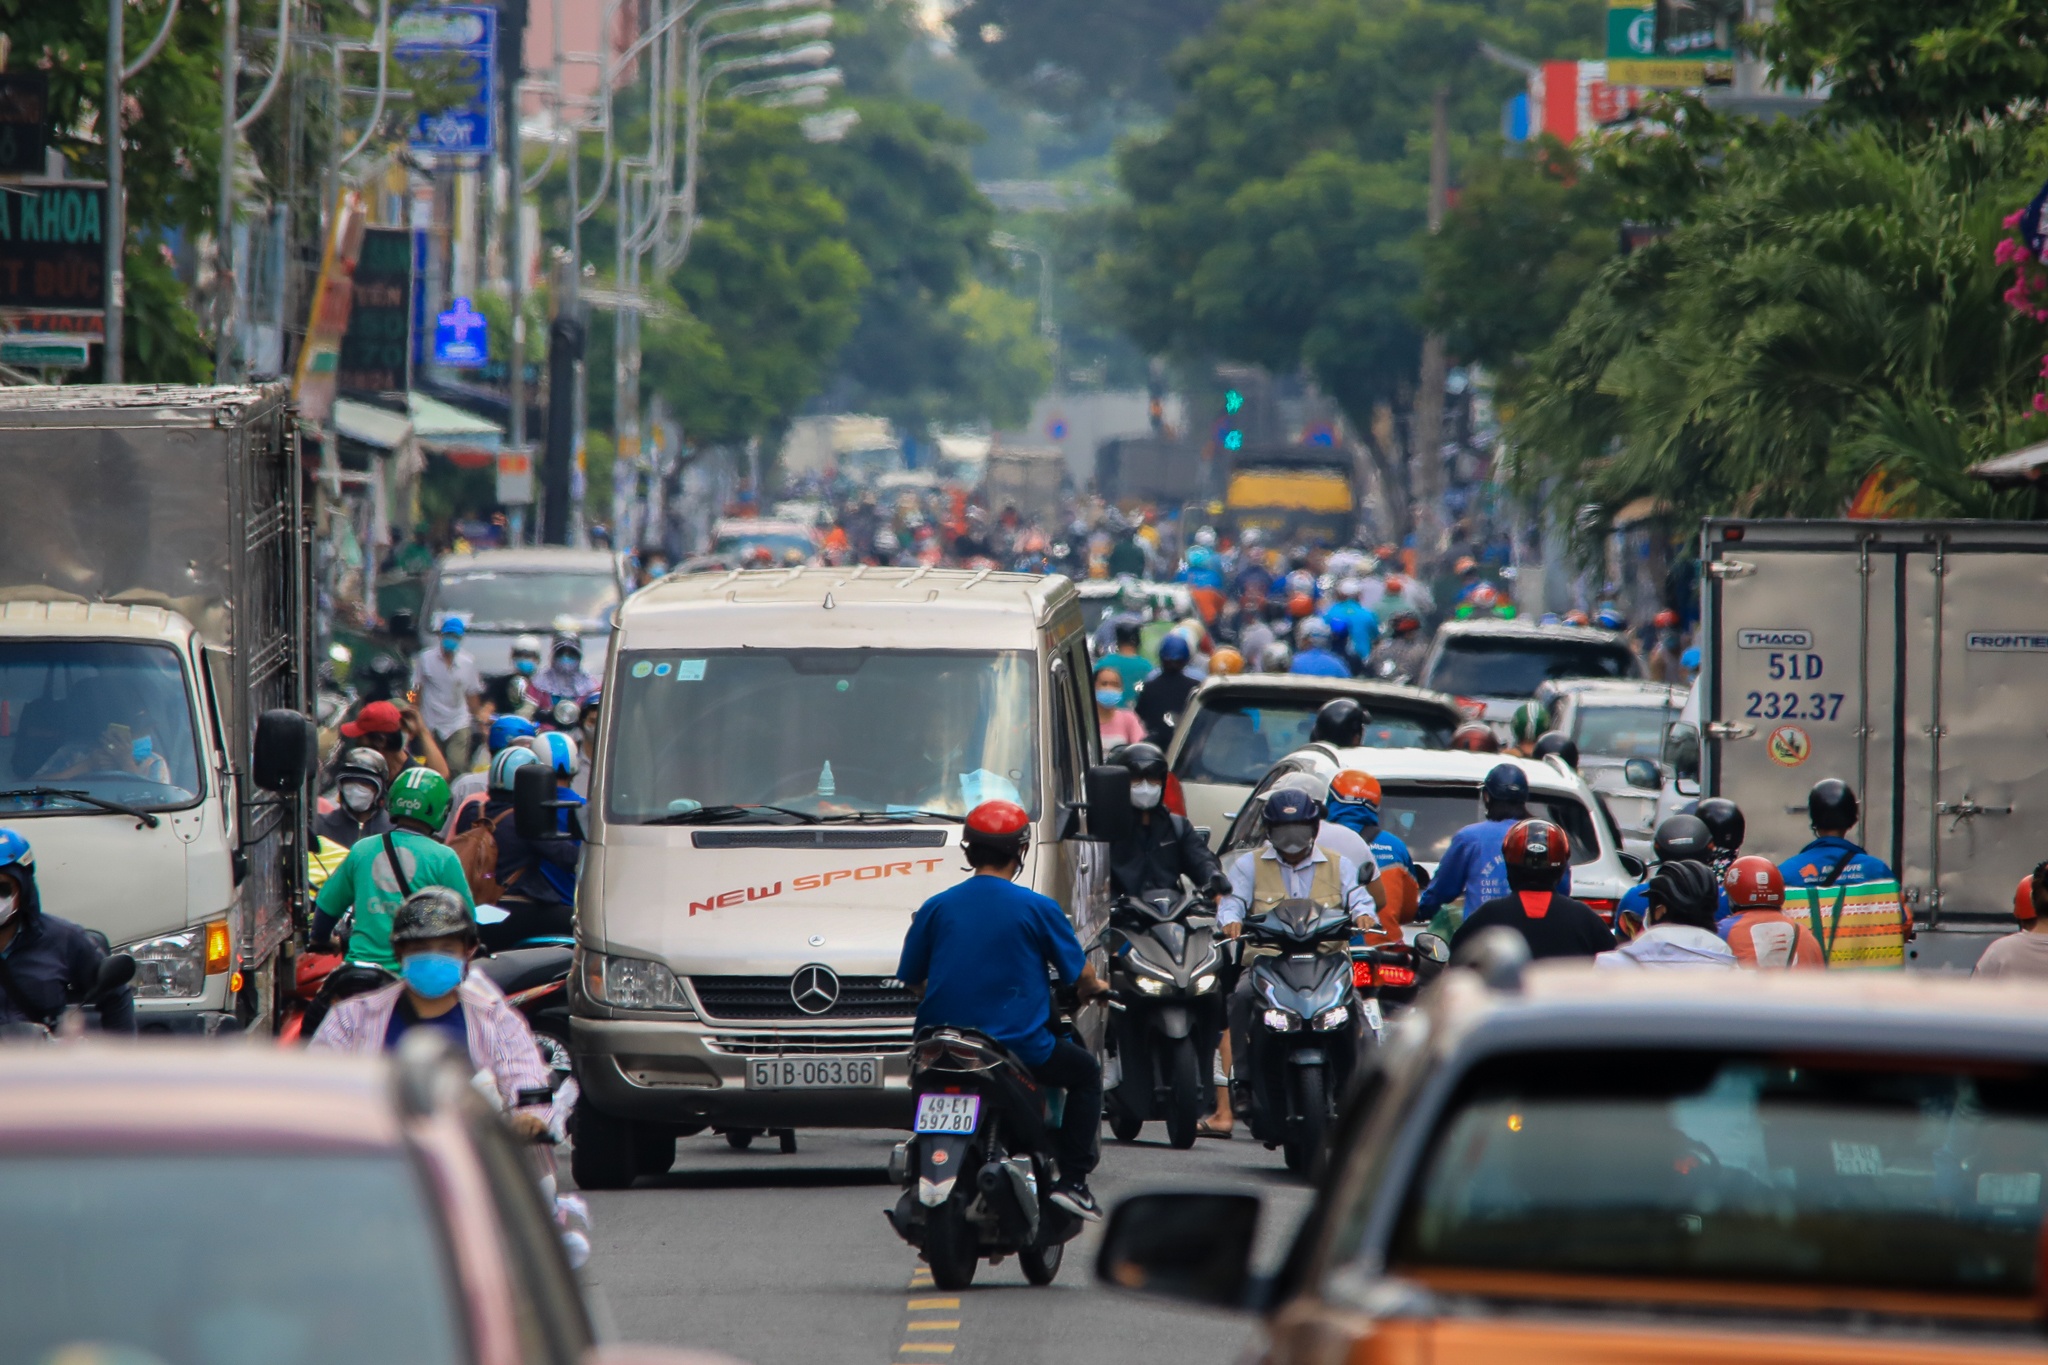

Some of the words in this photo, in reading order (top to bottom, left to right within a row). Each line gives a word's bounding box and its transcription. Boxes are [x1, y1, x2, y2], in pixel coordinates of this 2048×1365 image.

[20, 188, 101, 244] KHOA
[1744, 633, 1807, 645] THACO
[1970, 636, 2048, 648] FRONTIE
[1768, 653, 1823, 680] 51D
[1745, 691, 1845, 721] 232.37
[396, 797, 421, 810] Grab
[689, 881, 782, 917] NEW
[793, 858, 944, 891] SPORT
[368, 897, 398, 915] Gra
[755, 1062, 872, 1086] 51B-063.66
[928, 1098, 968, 1113] 49-E1
[919, 1114, 973, 1131] 597.80
